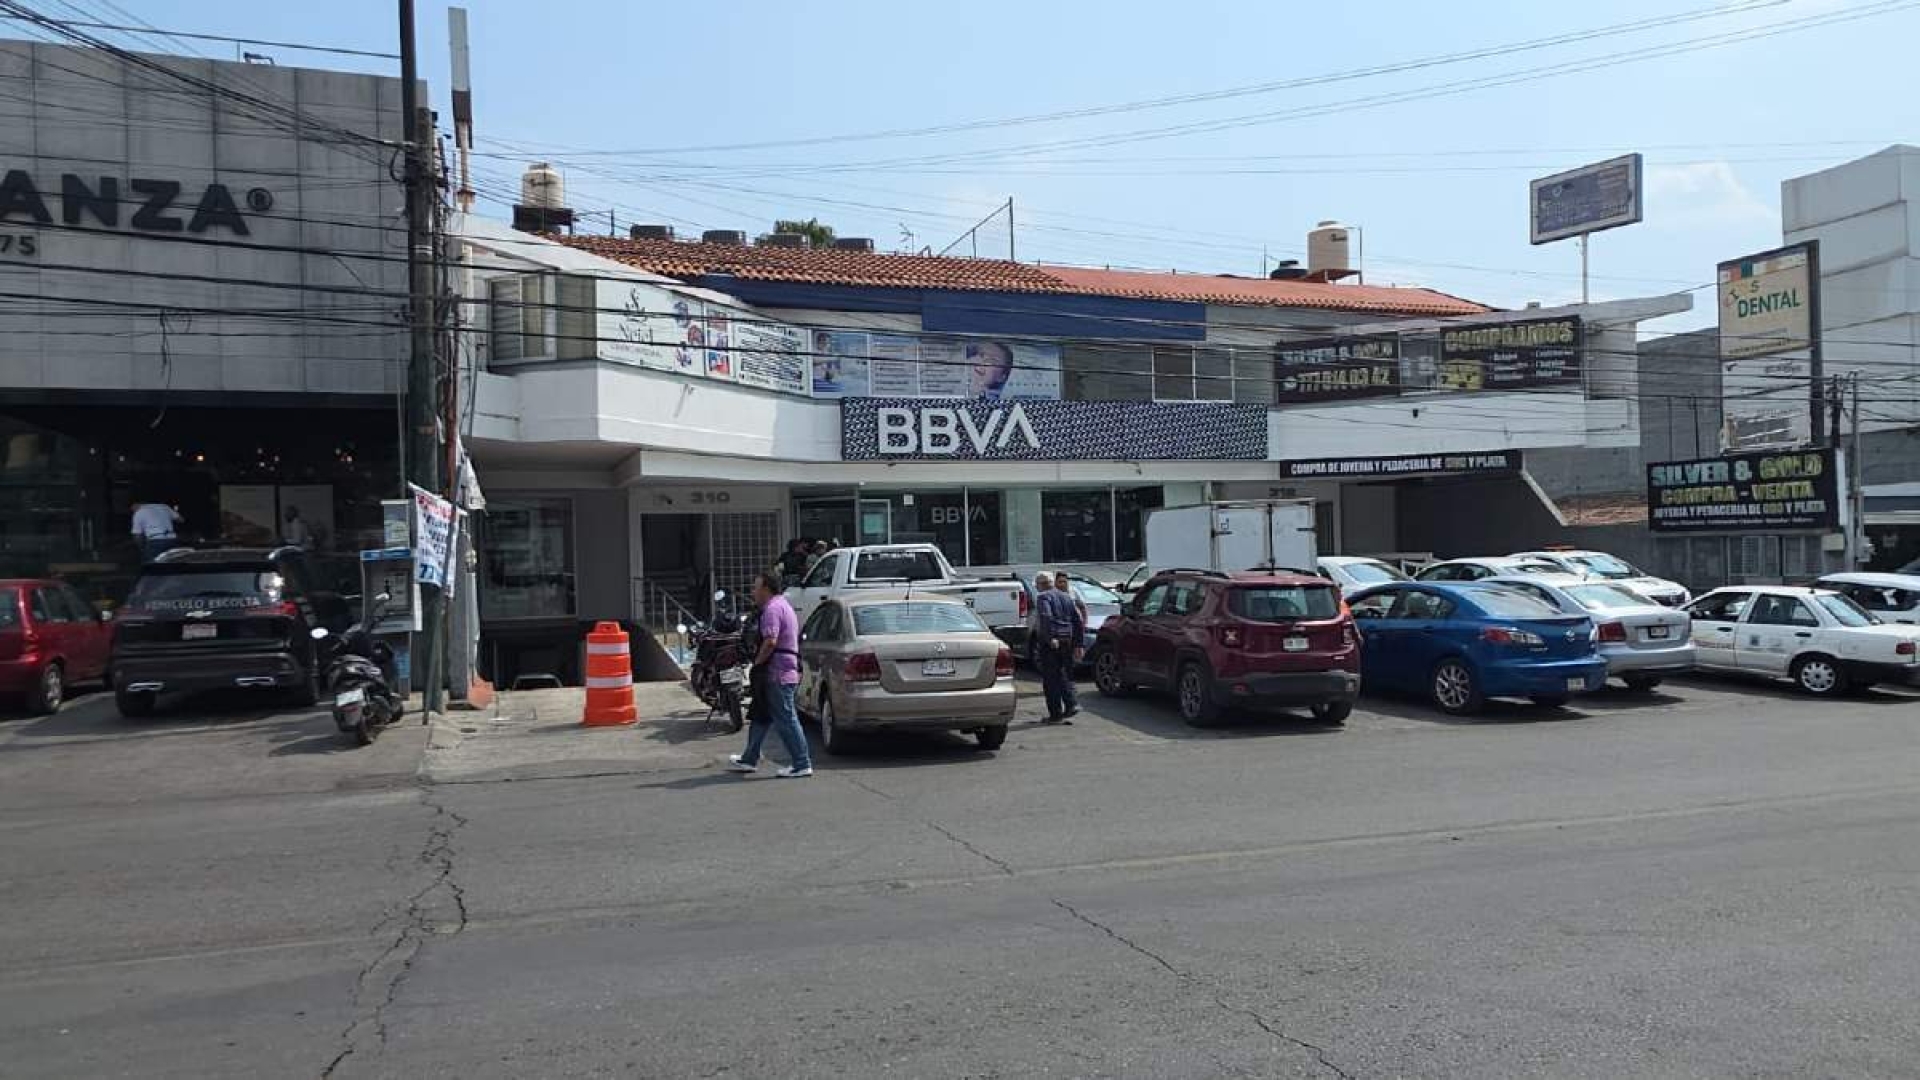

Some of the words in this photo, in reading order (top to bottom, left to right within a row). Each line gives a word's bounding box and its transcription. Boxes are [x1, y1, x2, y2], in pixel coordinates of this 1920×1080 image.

[1738, 287, 1801, 318] DENTAL
[878, 402, 1041, 454] BBVA
[1291, 463, 1327, 475] COMPRA
[1328, 461, 1340, 473] DE
[1431, 457, 1442, 469] DE
[1468, 457, 1475, 468] Y
[1476, 455, 1507, 468] PLATA
[1651, 461, 1729, 486] SILVER
[1759, 453, 1823, 479] GOLD
[691, 490, 730, 504] 310
[1661, 485, 1738, 504] COMPRA
[1752, 481, 1815, 500] VENTA
[931, 505, 987, 524] BBVA
[1748, 503, 1760, 514] DE
[1794, 500, 1826, 513] PLATA
[209, 597, 261, 609] ESCOLTA
